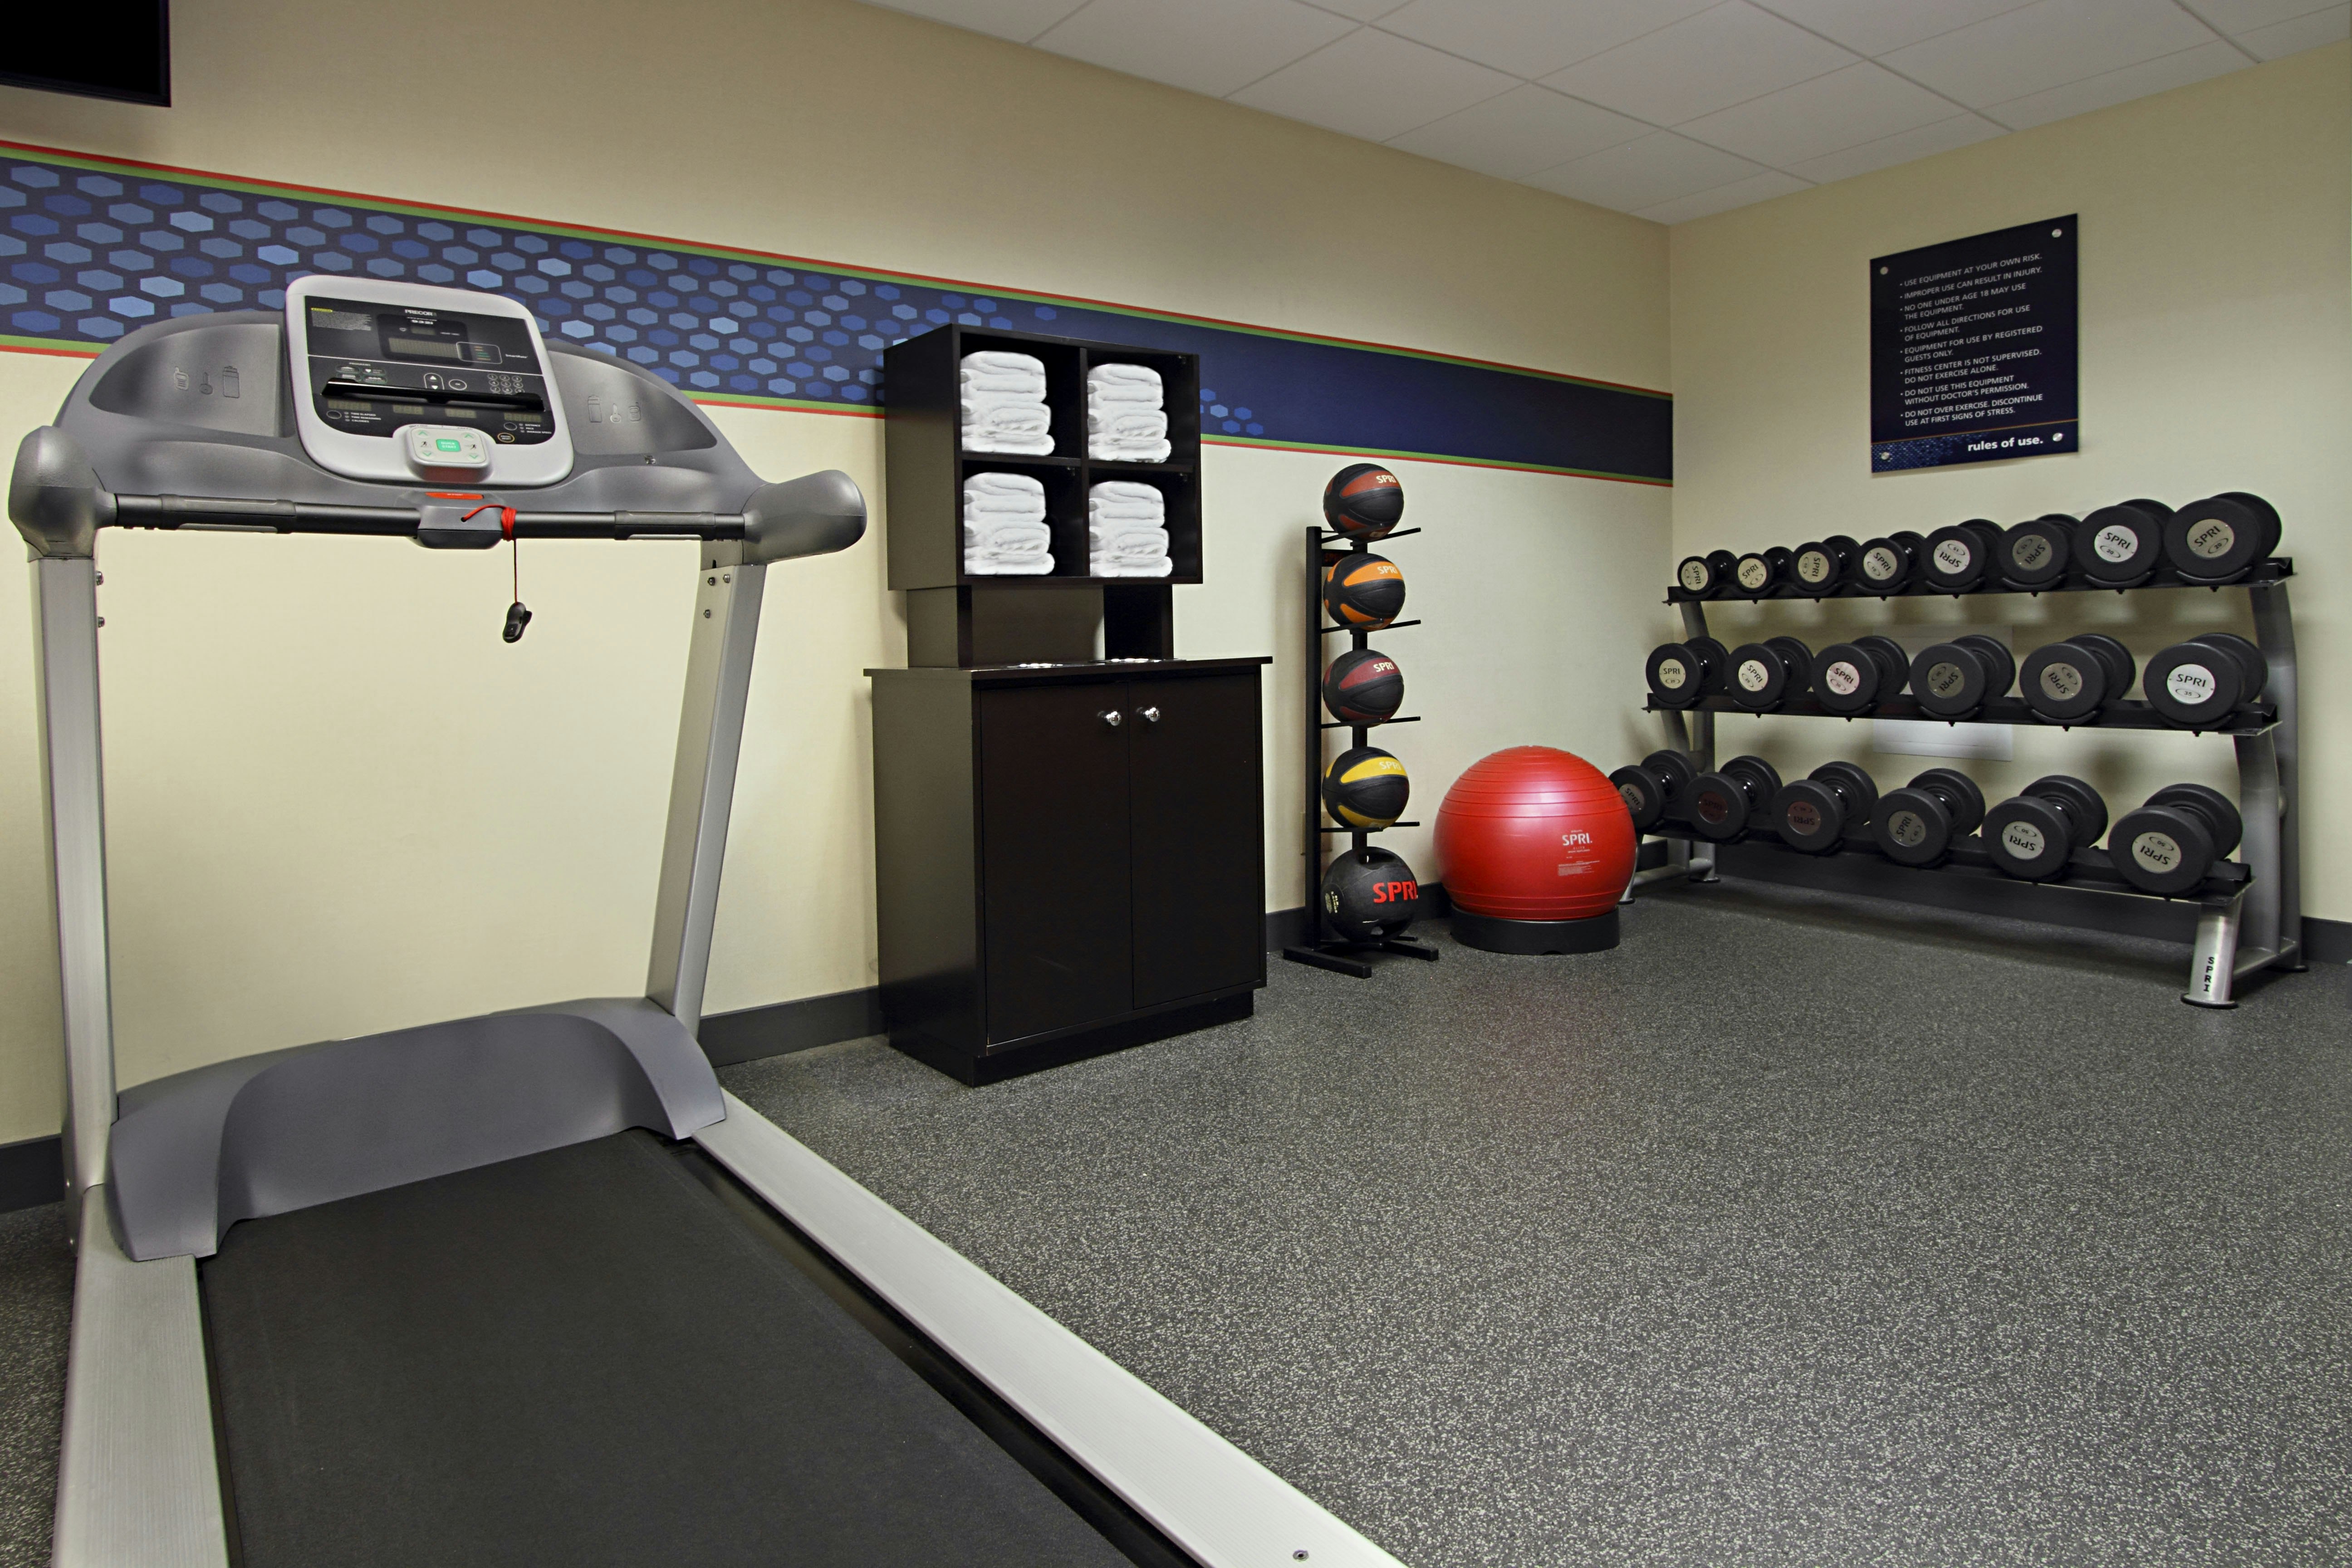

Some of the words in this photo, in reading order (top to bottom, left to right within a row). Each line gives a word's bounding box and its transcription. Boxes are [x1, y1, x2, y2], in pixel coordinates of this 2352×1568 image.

[1904, 278, 1917, 286] USE
[1919, 269, 1962, 284] EQUIPMENT
[1975, 262, 1998, 271] YOUR
[1999, 257, 2020, 267] OWN
[2022, 253, 2043, 262] RISK.
[1904, 286, 1940, 299] IMPROPER
[1941, 283, 1955, 292] USE
[1956, 280, 1973, 289] CAN
[1974, 274, 2001, 285] RESULT
[2013, 266, 2043, 277] INJURY.
[1917, 300, 1932, 309] ONE
[1934, 295, 1960, 305] UNDER
[1961, 292, 1977, 300] AGE
[1990, 286, 2009, 295] MAY
[2011, 283, 2026, 291] USE
[1904, 322, 1935, 333] FOLLOW
[1951, 310, 1995, 324] DIRECTIONS
[1997, 308, 2013, 316] FOR
[2015, 304, 2030, 313] USE
[1920, 304, 1964, 317] EQUIPMENT.
[1904, 341, 1947, 354] EQUIPMENT
[1949, 338, 1964, 347] FOR
[1966, 335, 1980, 343] USE
[1994, 325, 2043, 339] REGISTERED
[1916, 326, 1960, 339] EQUIPMENT.
[1904, 353, 1931, 363] GUESTS
[1932, 349, 1954, 358] ONLY.
[1904, 365, 1932, 375] FITNESS
[1934, 360, 1962, 370] CENTER
[1973, 356, 1990, 364] NOT
[1991, 348, 2042, 362] SUPERVISED.
[1917, 374, 1933, 382] NOT
[1935, 368, 1968, 379] EXERCISE
[1970, 364, 1999, 374] ALONE.
[1968, 374, 2014, 387] EQUIPMENT
[1904, 394, 1939, 405] WITHOUT
[1941, 389, 1979, 400] DOCTOR'S
[1980, 382, 2029, 395] PERMISSION.
[1917, 408, 1933, 416] NOT
[1934, 406, 1954, 414] OVER
[1955, 401, 1989, 411] EXERCISE.
[1991, 393, 2043, 407] DISCONTINUE
[1931, 415, 1950, 423] FIRST
[1951, 412, 1973, 421] SIGNS
[1987, 407, 2016, 416] STRESS.
[1968, 441, 1998, 451] rules
[2001, 437, 2014, 447] of
[2018, 437, 2043, 446] use.
[1376, 475, 1396, 483] SPRI
[2104, 532, 2131, 549] SPRI
[2194, 526, 2221, 547] SPRI
[1873, 553, 1891, 571] SPRI
[1939, 552, 1961, 568] SPRI
[2025, 544, 2045, 564] SPRI
[1377, 566, 1398, 574] SPRI
[1692, 566, 1701, 584] SPRI
[1742, 564, 1759, 579] SPRI
[1812, 558, 1821, 577] SPRI
[1373, 662, 1395, 672] SPRI
[1747, 665, 1763, 683] SPRI
[1833, 668, 1854, 684] SPRI
[1939, 672, 1958, 691] SPRI
[2048, 672, 2069, 694] SPRI
[2176, 674, 2206, 687] SPRI
[1379, 761, 1401, 770] SPRI
[1625, 788, 1640, 805] SPRI
[1793, 816, 1815, 825] SPRI
[1896, 816, 1912, 837] SPRI
[2009, 835, 2036, 851] SPRI
[2140, 845, 2171, 865] SPRI
[2203, 956, 2215, 992] SPRI
